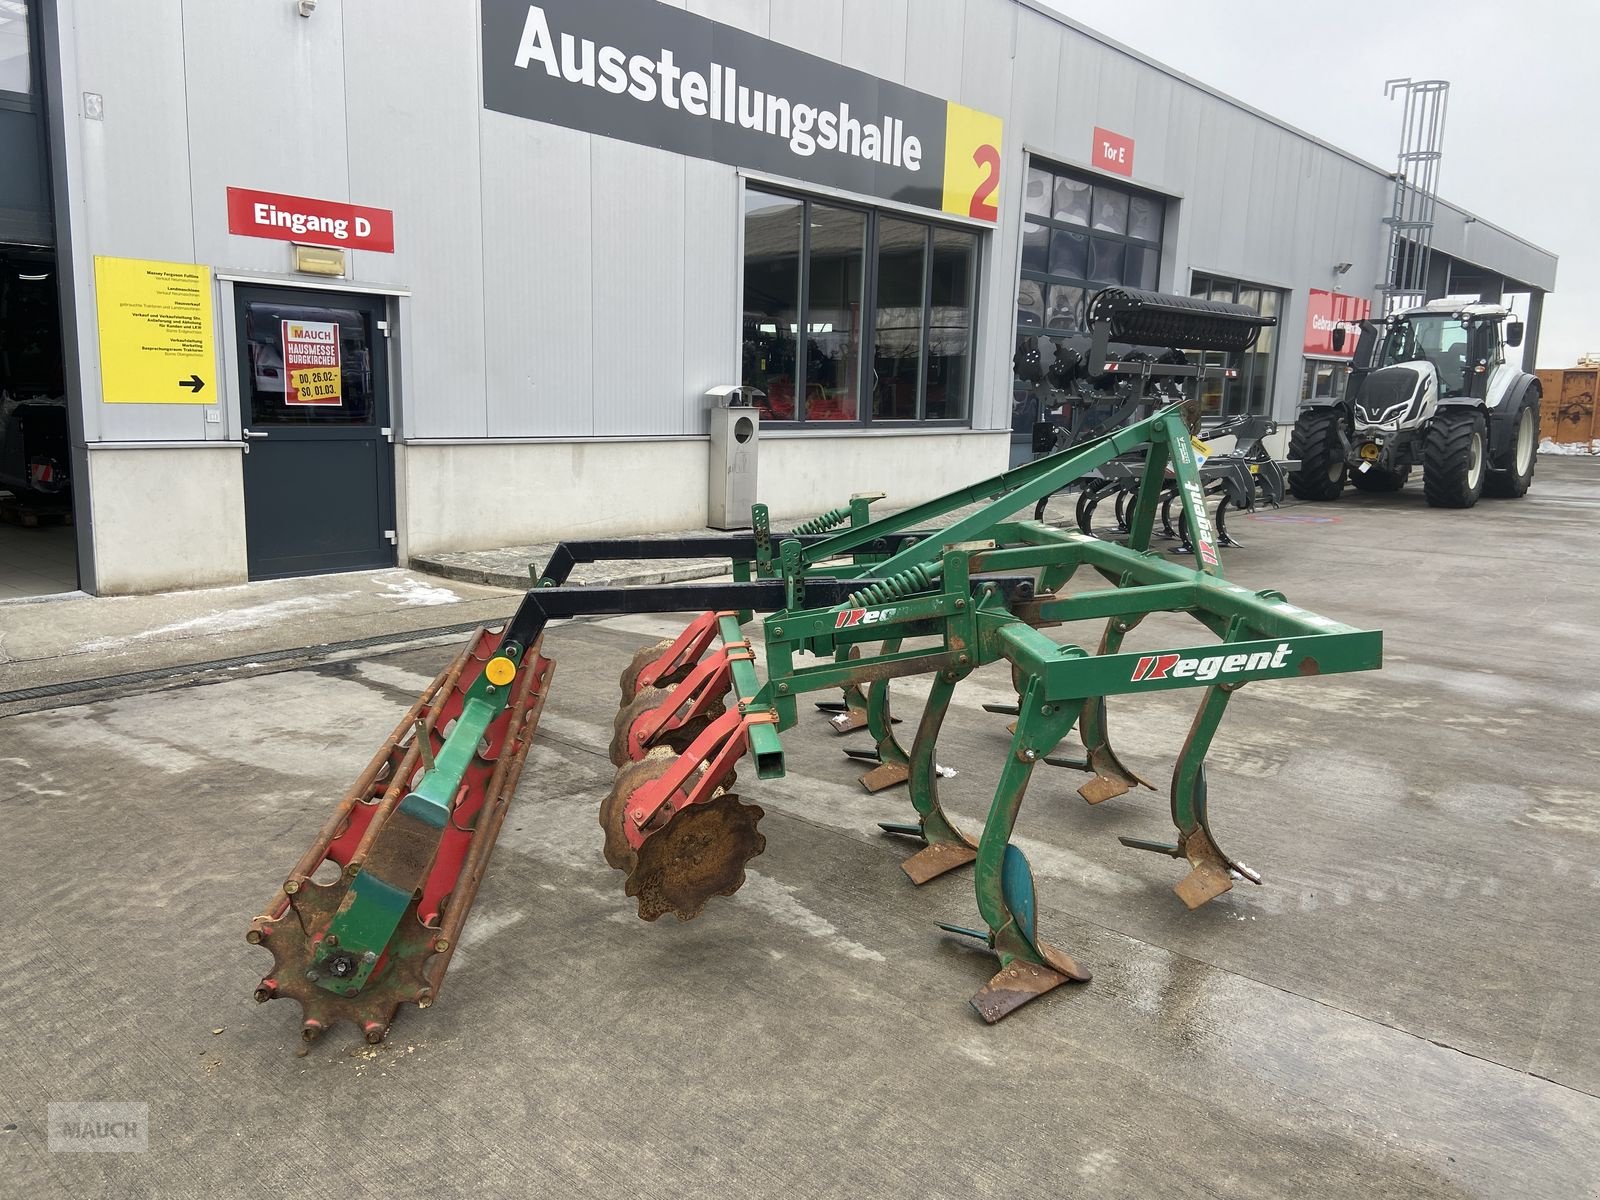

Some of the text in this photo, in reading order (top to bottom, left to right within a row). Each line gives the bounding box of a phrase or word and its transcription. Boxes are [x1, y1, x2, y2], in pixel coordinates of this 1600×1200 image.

[514, 6, 922, 172] Ausstellungshalle
[1103, 142, 1125, 164] Tor E
[970, 144, 1001, 222] 2
[254, 203, 371, 238] Eingang D
[288, 343, 335, 356] HAUSMESSE
[294, 328, 331, 341] MAUCH
[288, 354, 336, 366] BURGKIRCHEN
[1184, 481, 1218, 566] Regent
[1130, 643, 1293, 682] Regent
